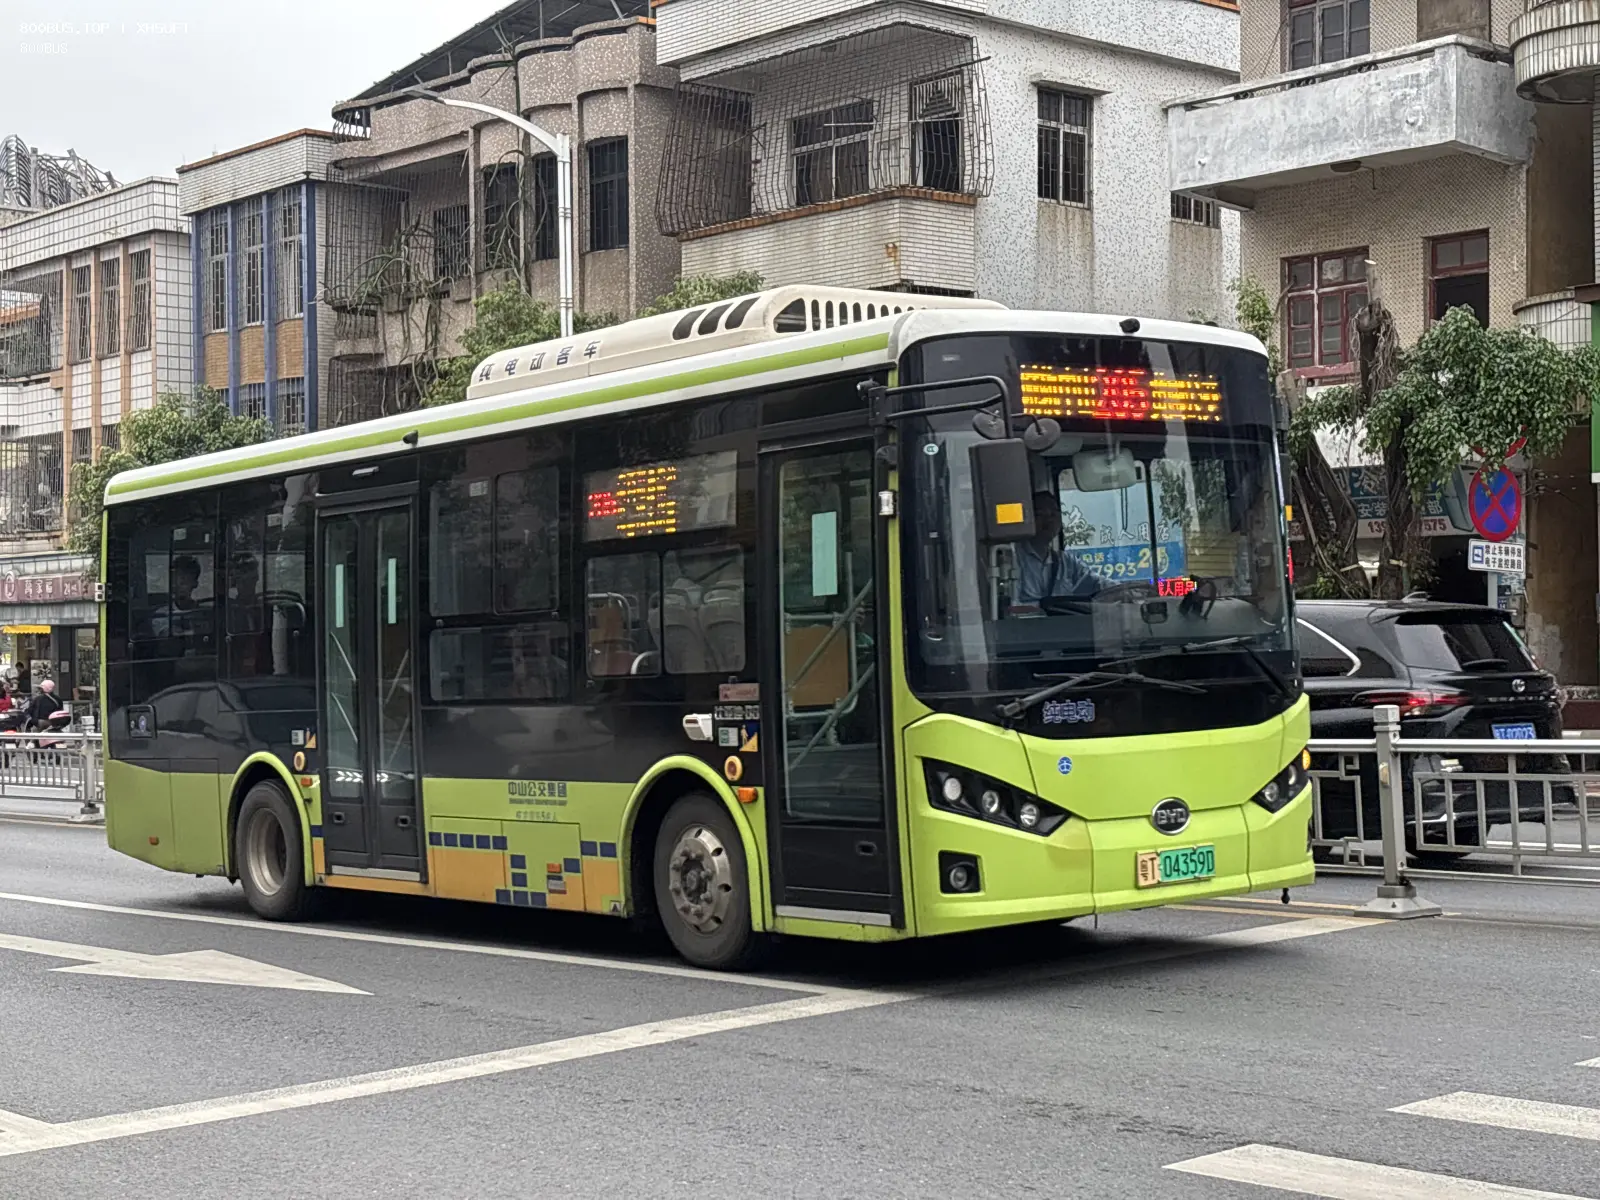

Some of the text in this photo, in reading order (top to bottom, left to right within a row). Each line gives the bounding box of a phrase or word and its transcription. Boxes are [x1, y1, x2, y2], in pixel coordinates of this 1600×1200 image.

[479, 340, 601, 382] 纯电动客车
[1042, 699, 1096, 724] 纯电动
[1156, 807, 1188, 826] BYD
